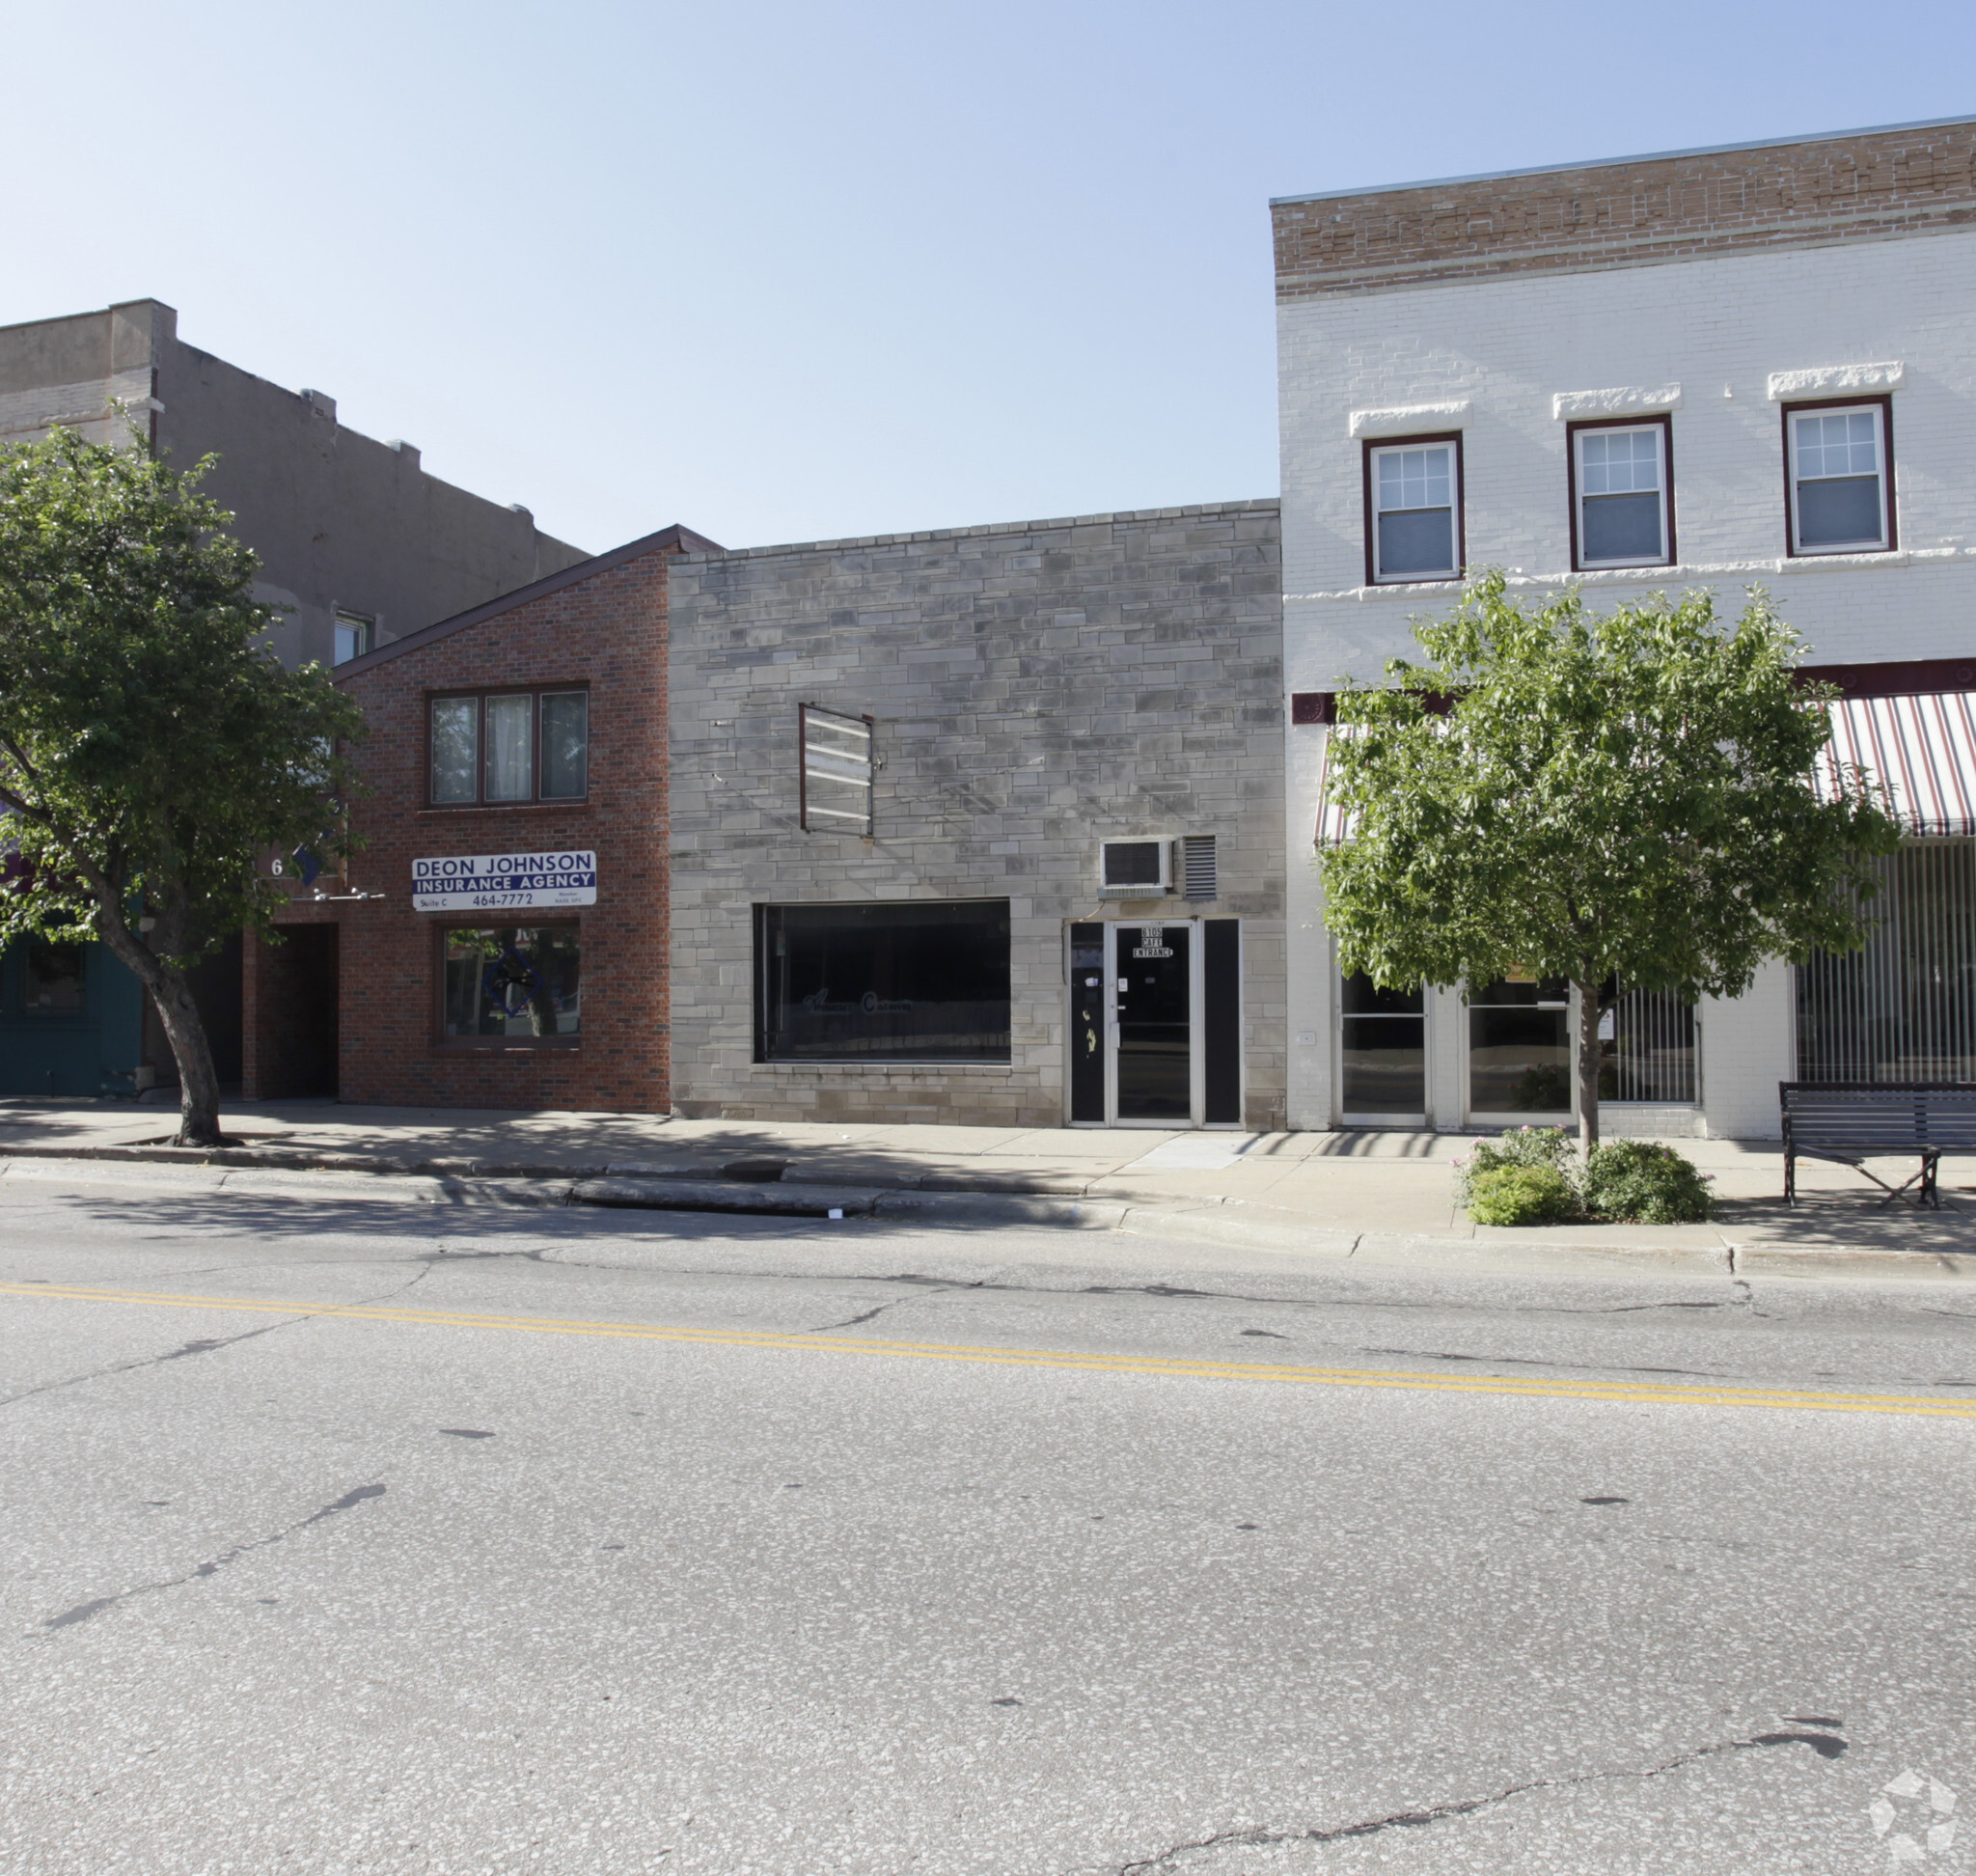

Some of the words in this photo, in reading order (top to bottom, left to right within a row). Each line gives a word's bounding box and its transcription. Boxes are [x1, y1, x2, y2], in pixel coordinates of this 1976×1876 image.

[417, 859, 475, 877] DEON
[486, 853, 591, 874] JOHNSON
[417, 876, 511, 893] INSURANCE
[520, 873, 591, 889] AGENCY
[441, 898, 448, 907] C
[473, 893, 533, 907] 464-7772
[1142, 927, 1162, 937] 6105
[1142, 938, 1162, 948] CAFE
[1134, 948, 1172, 957] ENTRANCE
